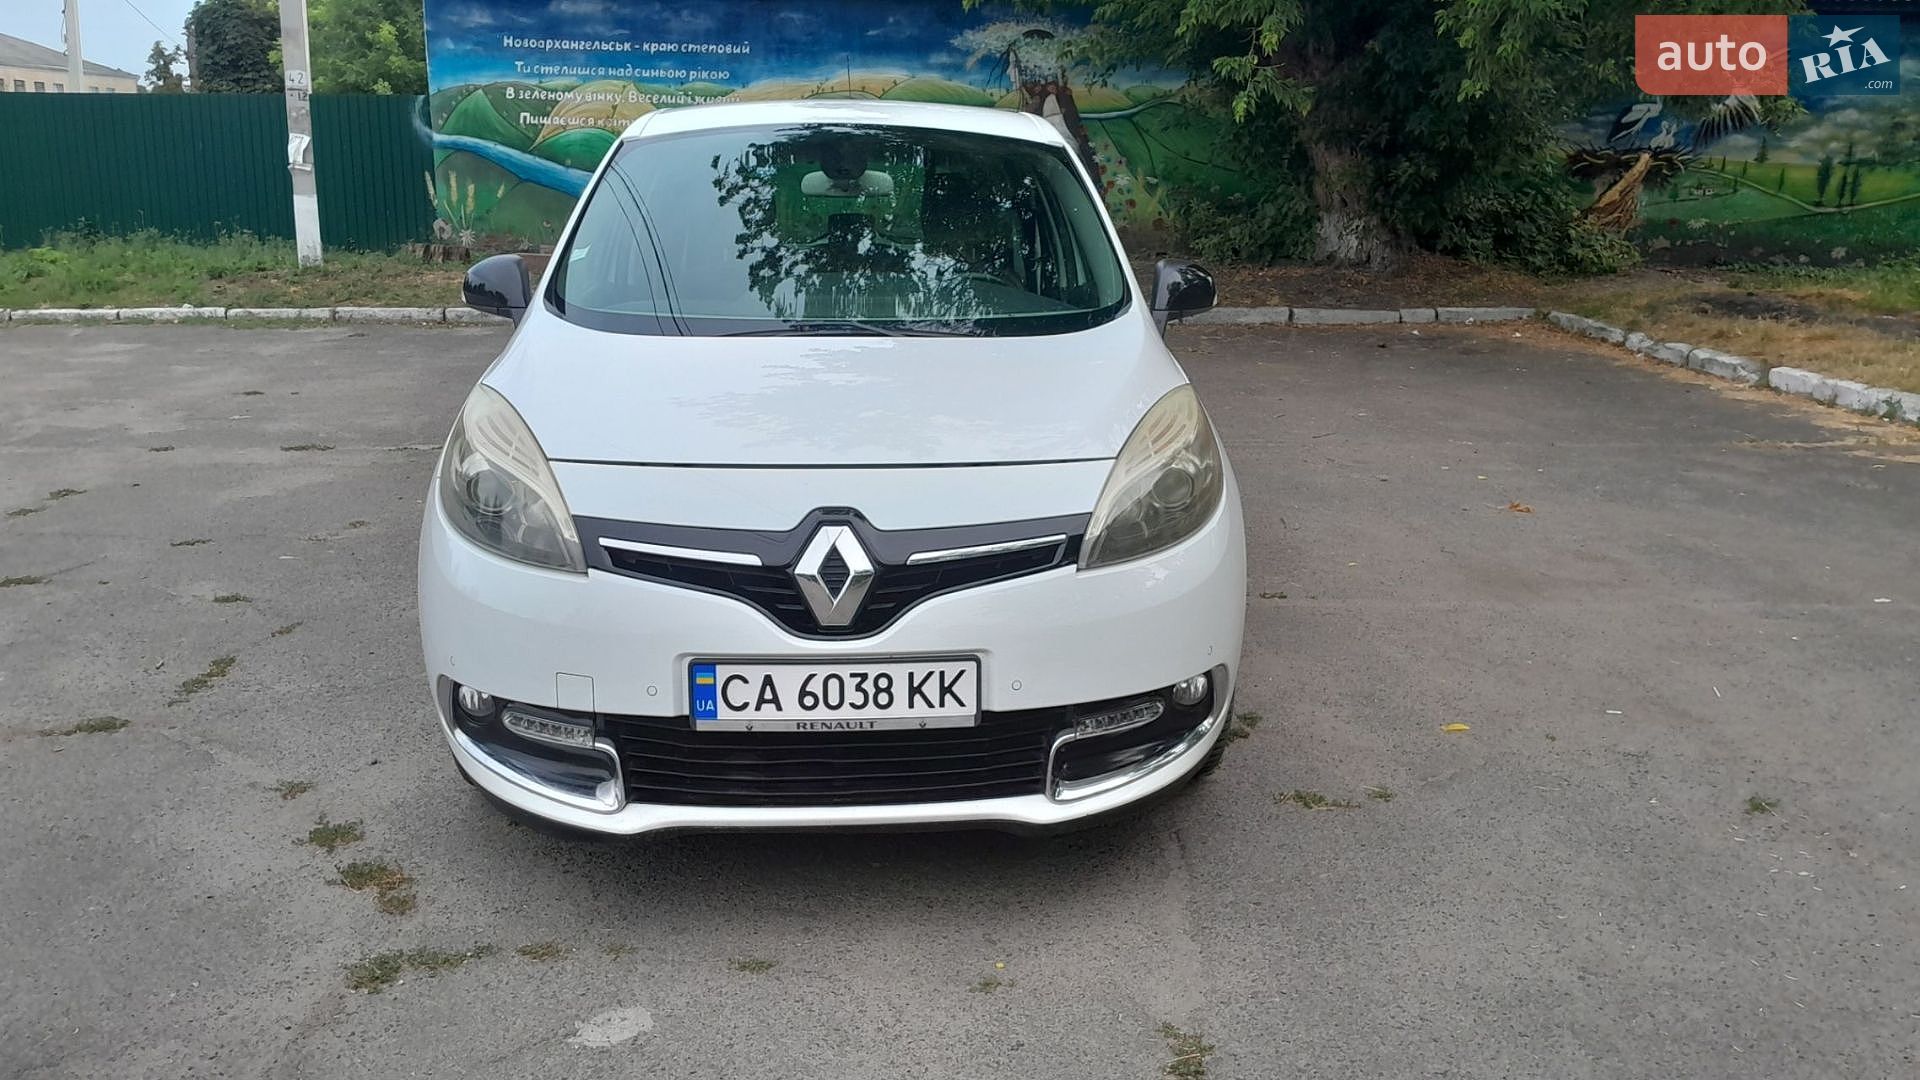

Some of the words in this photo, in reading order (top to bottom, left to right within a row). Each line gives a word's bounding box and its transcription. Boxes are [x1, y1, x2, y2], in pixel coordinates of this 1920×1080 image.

[503, 35, 631, 52] Новоархангельськ
[643, 40, 679, 54] краю
[681, 41, 751, 54] степовий
[288, 72, 304, 85] 42
[514, 61, 530, 73] Ти
[533, 64, 605, 76] стелишся
[608, 63, 634, 77] над
[634, 68, 687, 79] синьою
[689, 67, 729, 81] рікою
[505, 87, 515, 99] В
[518, 89, 582, 104] зеленому
[628, 91, 684, 105] Веселий
[696, 700, 715, 712] UA
[720, 673, 783, 712] CA
[798, 672, 894, 711] 6038
[908, 669, 967, 709] KK
[795, 721, 878, 731] RENAULT
